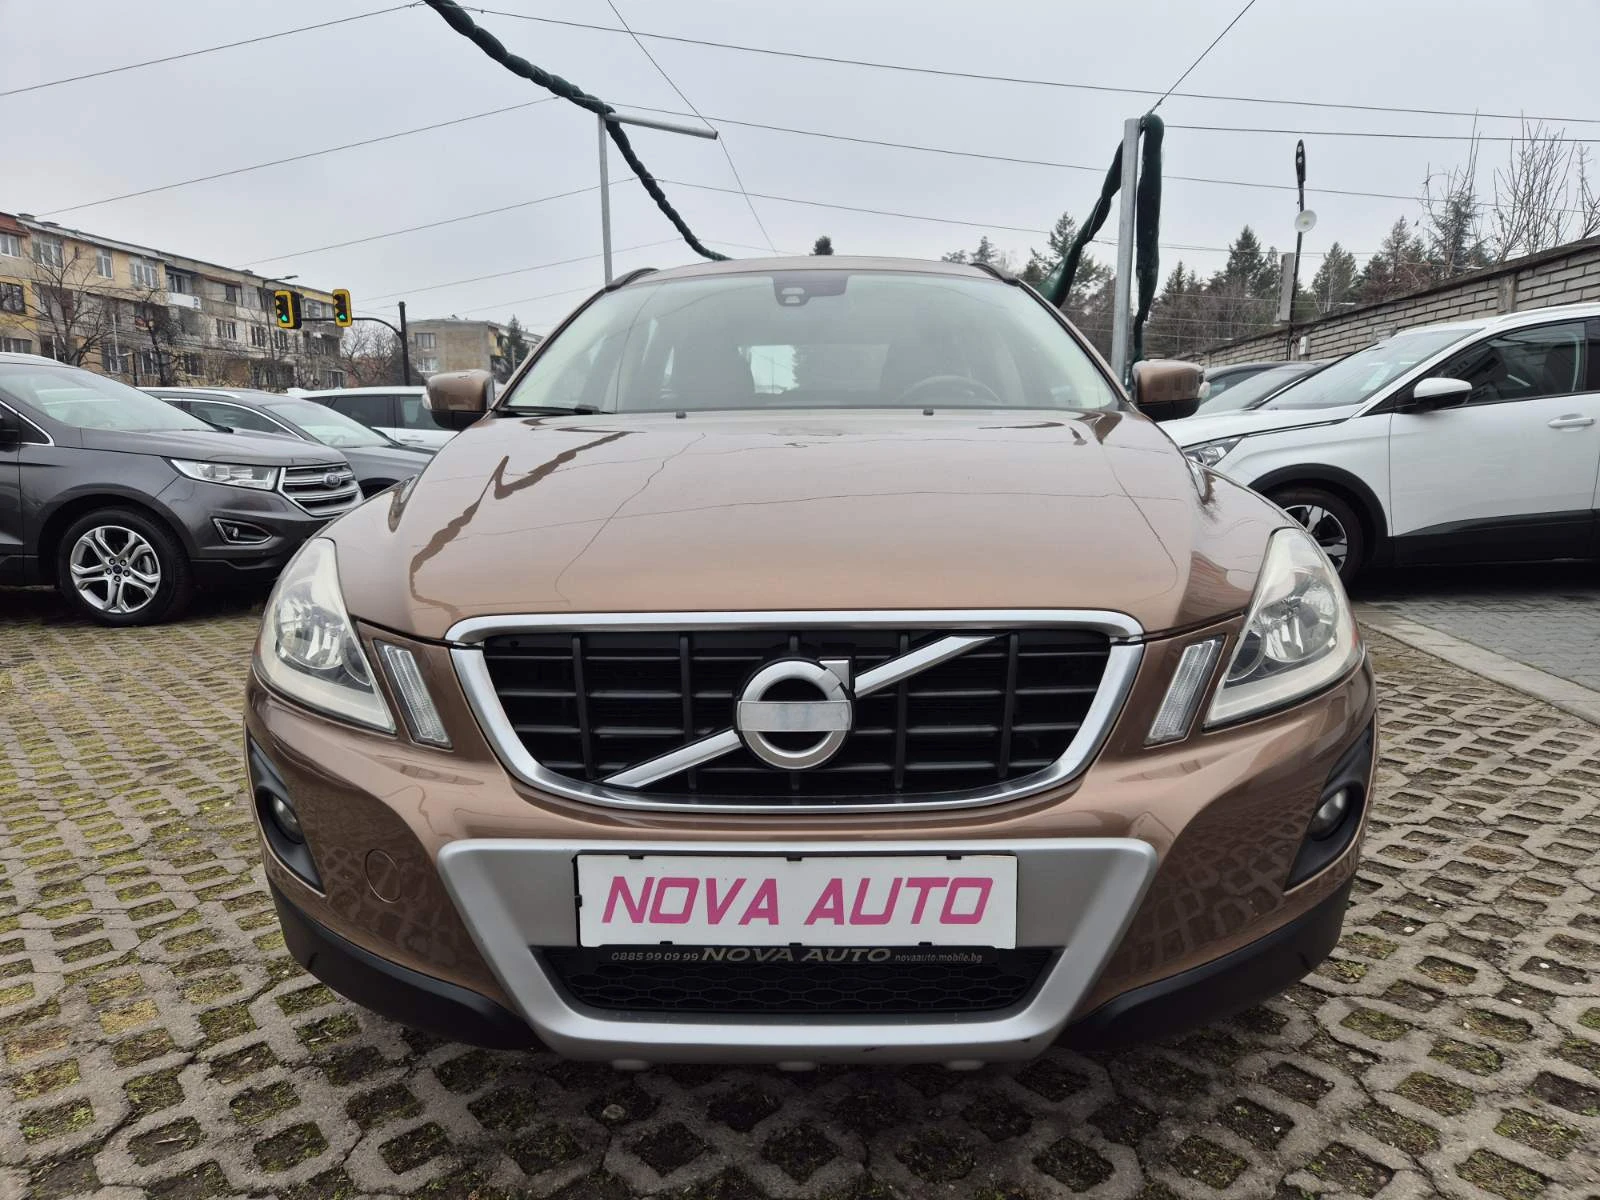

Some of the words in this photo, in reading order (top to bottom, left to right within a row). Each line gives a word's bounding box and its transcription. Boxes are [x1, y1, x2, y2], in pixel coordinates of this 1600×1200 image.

[602, 876, 779, 925] NOVA
[804, 877, 993, 925] AUTO
[610, 952, 643, 961] 0885
[701, 948, 794, 962] NOVA
[801, 948, 892, 962] AUTO
[894, 952, 983, 964] novaauto.mobile.bg
